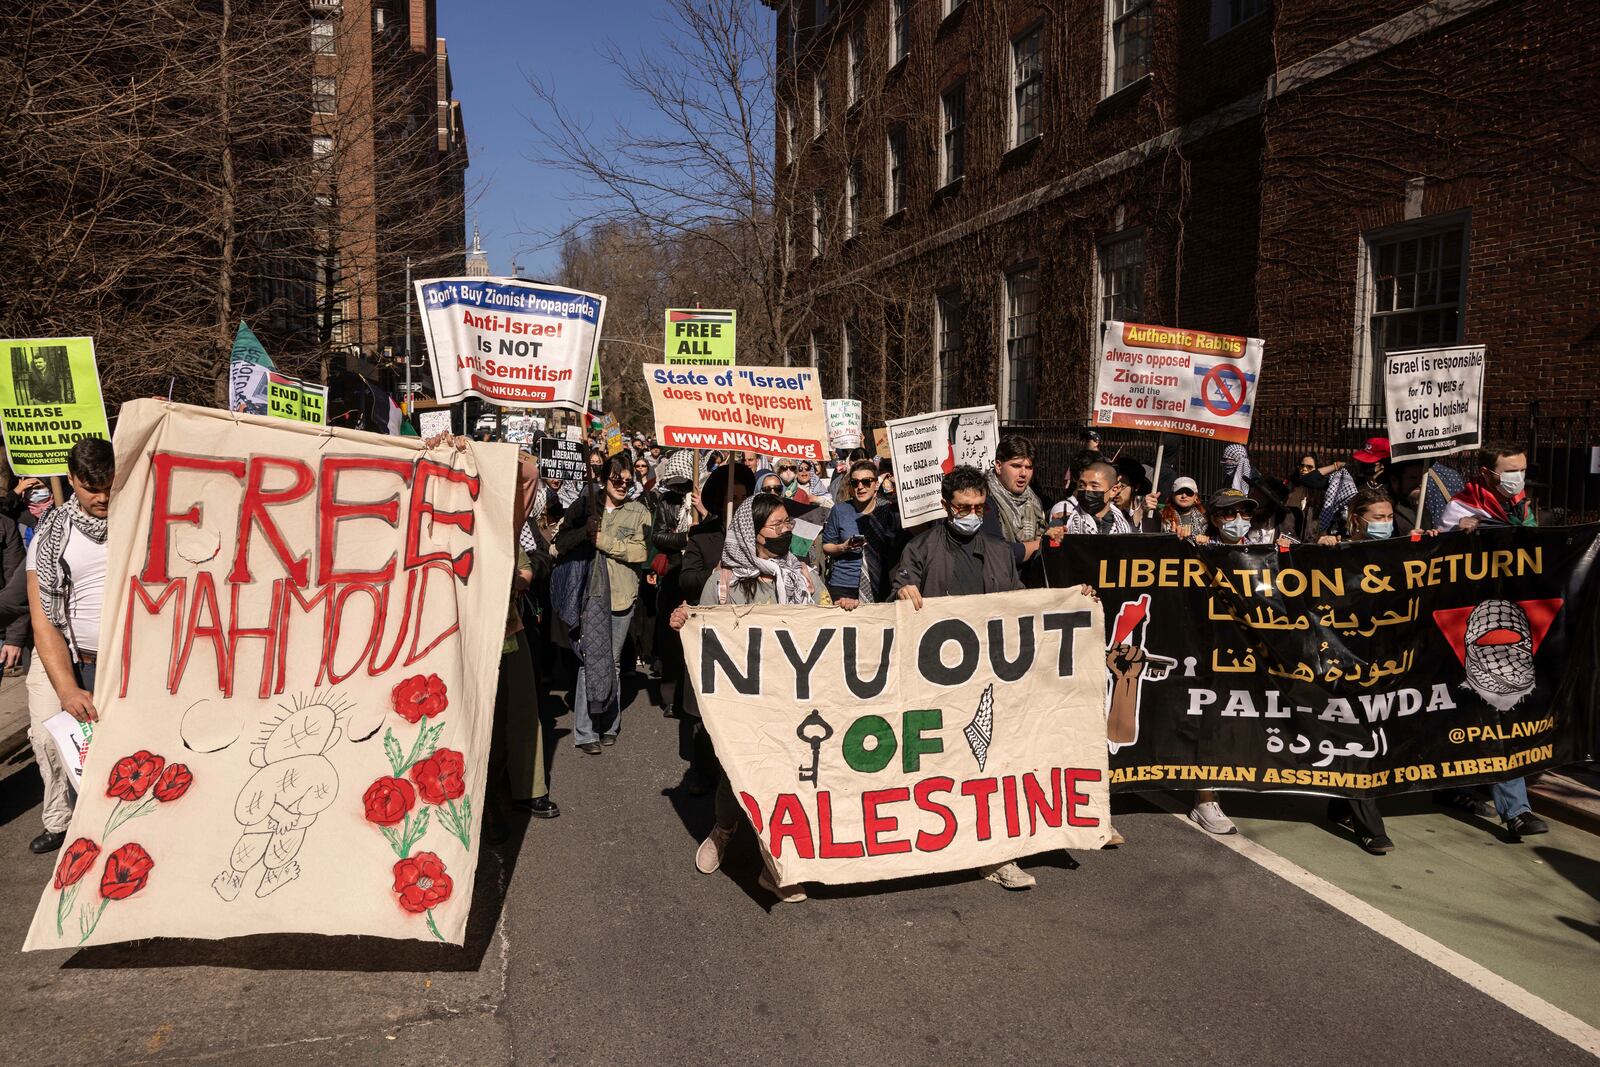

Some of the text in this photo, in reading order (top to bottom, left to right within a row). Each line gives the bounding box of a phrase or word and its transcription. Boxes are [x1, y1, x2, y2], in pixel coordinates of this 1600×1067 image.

[428, 285, 594, 319] Don't Buy Zionist Propaganda
[463, 310, 563, 338] Anti-Israel
[675, 323, 722, 338] FREE
[477, 335, 543, 358] Is NOT
[677, 341, 713, 355] ALL
[1127, 327, 1241, 353] Authentic Rabbis
[456, 354, 573, 382] Anti-Semitism
[1106, 348, 1191, 369] always opposed
[1388, 351, 1482, 375] Israel is responsible
[653, 368, 812, 391] State of "Israel"
[1113, 368, 1179, 387] Zionism
[1408, 386, 1419, 397] for
[1420, 381, 1433, 396] 76
[1437, 379, 1458, 398] years
[271, 385, 322, 410] END ALL
[477, 381, 547, 400] www.NKUSA.org
[662, 387, 813, 412] does not represent
[1128, 385, 1161, 396] and the
[3, 407, 64, 419] RELEASE
[271, 399, 321, 424] U.S. AID
[1100, 391, 1186, 413] State of Israel
[697, 407, 785, 435] world Jewry
[1395, 405, 1429, 424] tragic
[6, 420, 83, 432] MAHMOUD
[894, 424, 938, 440] Judaism Demands
[1134, 417, 1215, 436] www.NKUSA.org
[1405, 428, 1416, 440] of
[1418, 426, 1440, 439] Arab
[9, 434, 57, 446] KHALIL
[557, 440, 577, 451] WE SEE
[670, 430, 817, 459] www.NKUSA.org
[905, 440, 933, 454] FREEDOM
[11, 451, 44, 459] WORKERS
[541, 458, 557, 468] FROM
[551, 449, 583, 462] LIBERATION
[903, 456, 939, 473] for GAZA and
[547, 468, 583, 481] TO EVY SEA
[901, 479, 915, 492] ALL
[140, 450, 480, 587] FREE
[1098, 546, 1543, 598] LIBERATION & RETURN
[1320, 597, 1420, 638] الحرية
[118, 561, 461, 699] MAHMOUD
[701, 610, 1092, 700] NYU OUT
[1186, 682, 1457, 725] PAL-AWDA
[842, 708, 944, 774] OF
[1448, 715, 1554, 745] @PALAWDA
[1266, 727, 1388, 767] العودة
[1262, 767, 1390, 790] ASSEMBLY
[1394, 764, 1437, 784] FOR
[1441, 743, 1554, 778] LIBERATION
